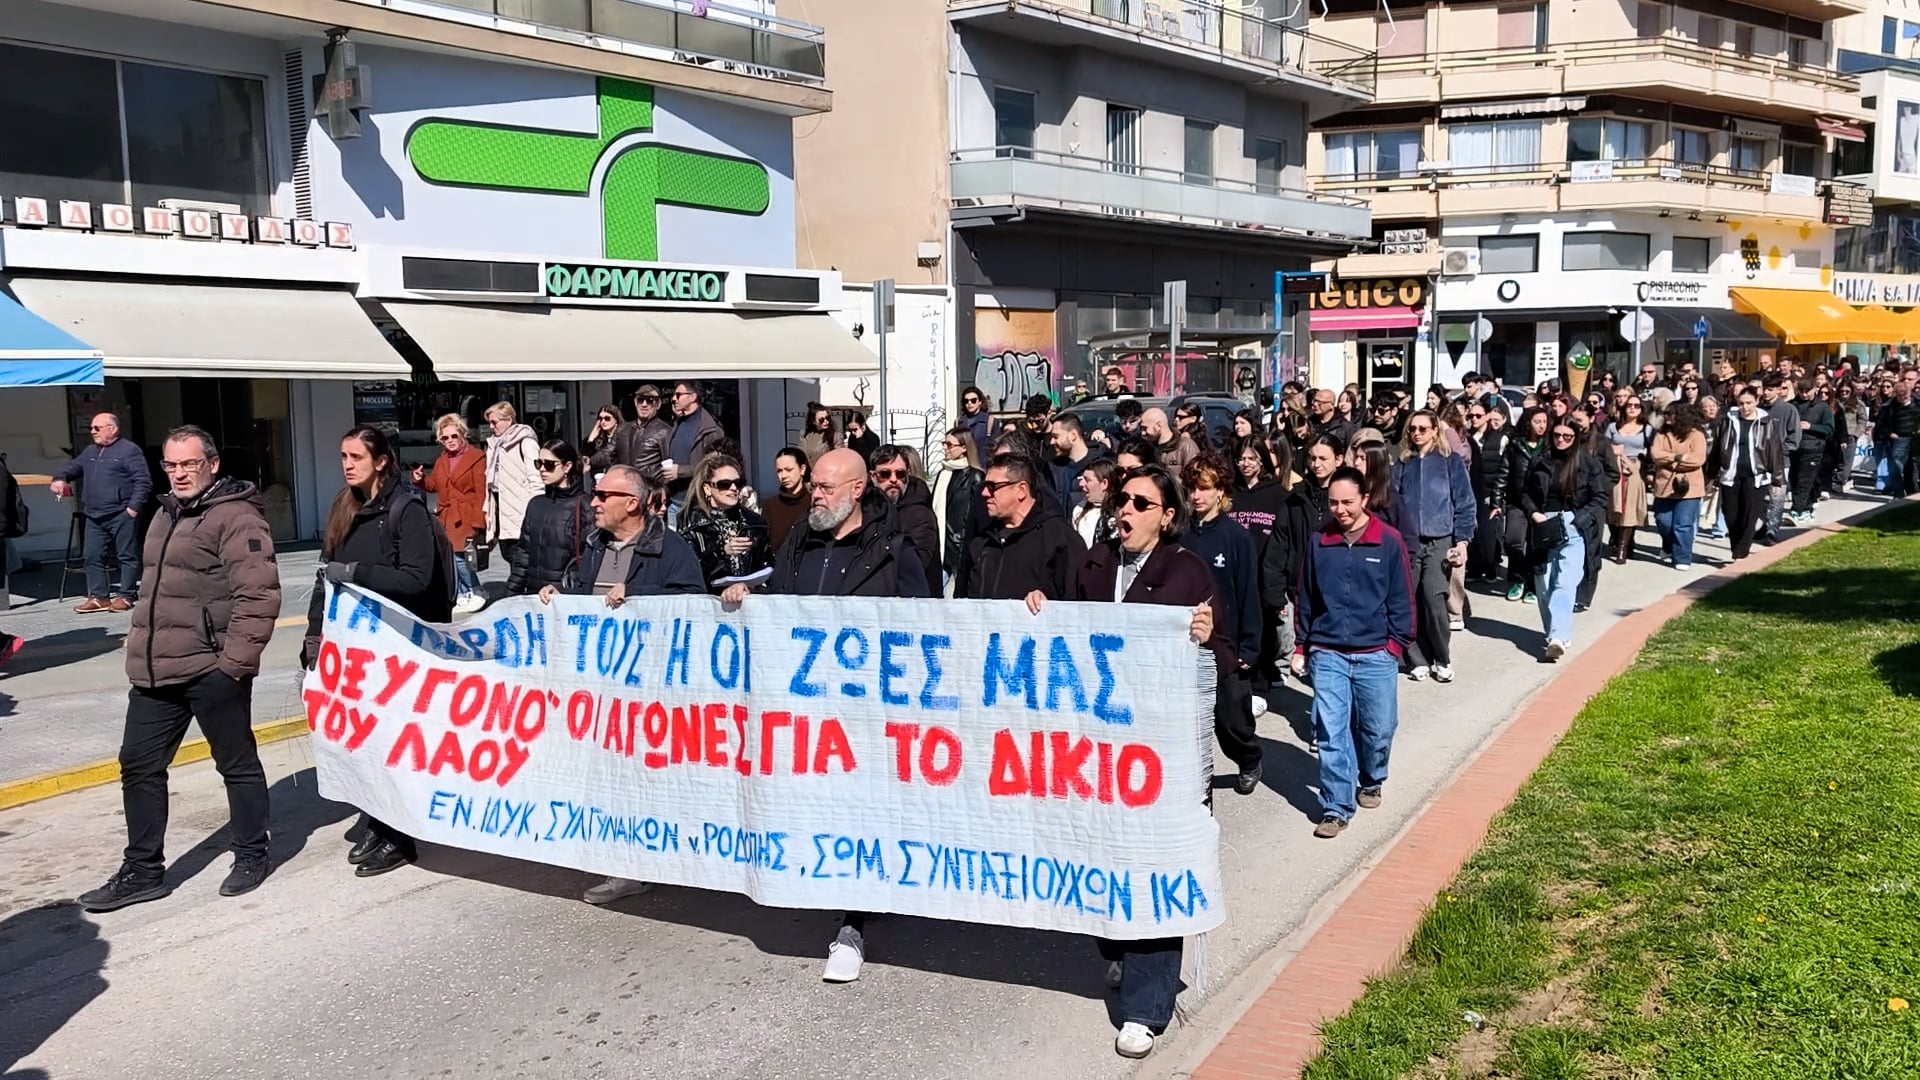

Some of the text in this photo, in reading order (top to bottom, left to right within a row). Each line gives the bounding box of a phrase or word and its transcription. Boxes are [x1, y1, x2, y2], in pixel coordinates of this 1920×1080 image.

[545, 264, 721, 300] ΦΑΡΜΑΚΕΙΟ
[1649, 280, 1700, 294] PISTACCHIO
[1238, 511, 1276, 521] CHANGING
[1246, 518, 1273, 526] THINGS
[568, 614, 651, 688] ΤΟΥΣ
[710, 622, 751, 694] ΟΙ
[788, 626, 960, 711] ΖΩΕΣ
[982, 632, 1135, 726] ΜΑΣ
[303, 688, 530, 788] ΤΟΥ ΛΑΟΥ
[603, 696, 751, 777] ΑΓΩΝΕΣ
[759, 710, 858, 776] ΓΙΑ
[885, 721, 964, 788] ΤΟ
[988, 727, 1165, 809] ΔΙΚΙΟ
[897, 838, 1133, 923] ΣΥΝΤΑΞΙΟΥΧΩΝ
[1150, 868, 1210, 924] ΙΚΑ
